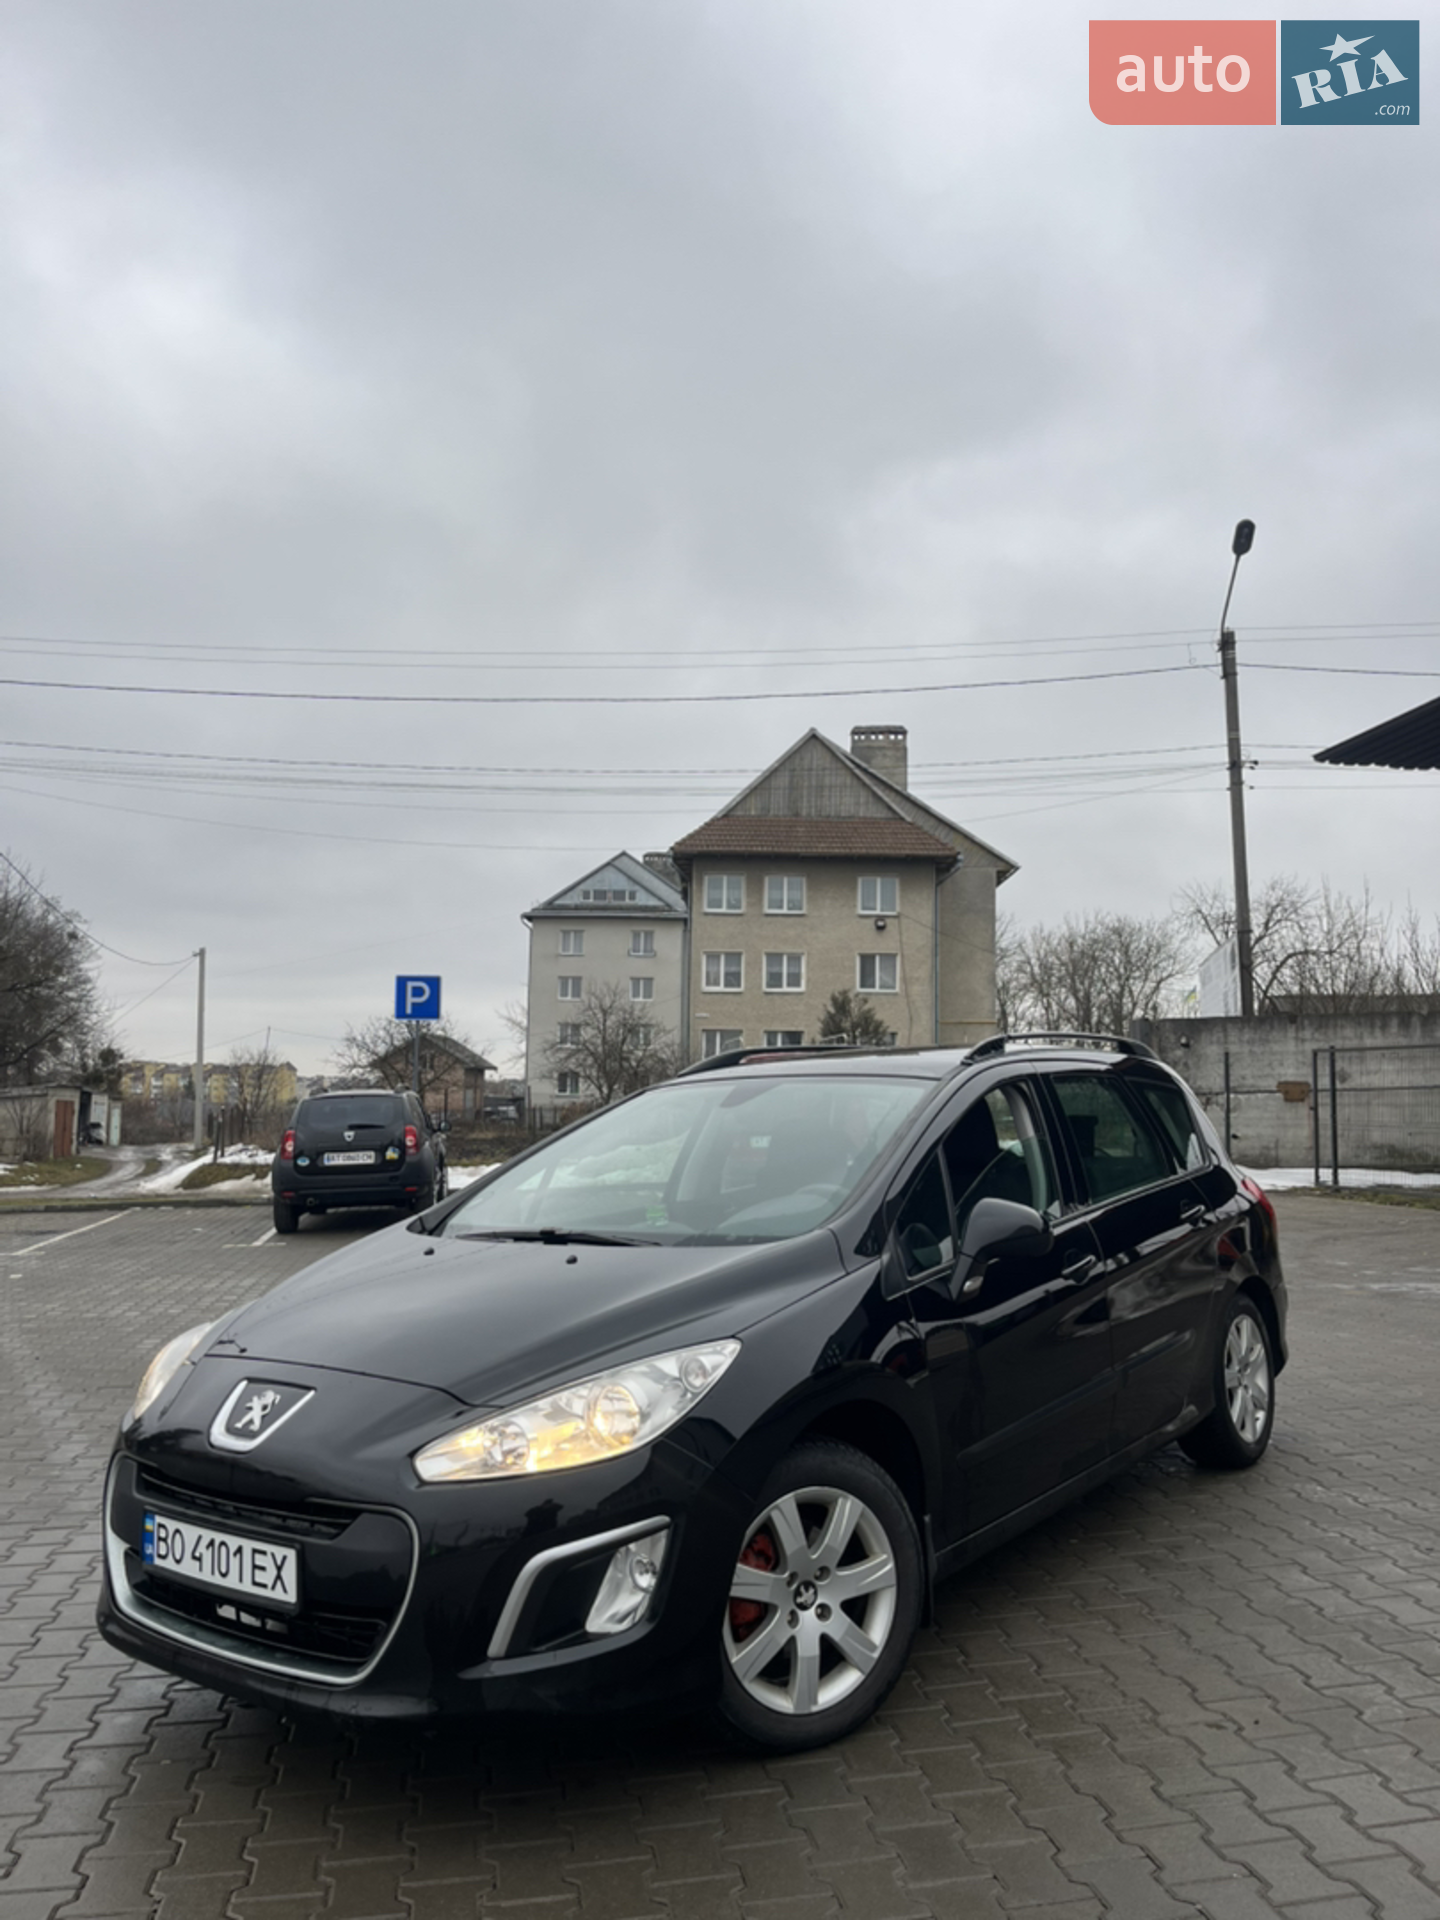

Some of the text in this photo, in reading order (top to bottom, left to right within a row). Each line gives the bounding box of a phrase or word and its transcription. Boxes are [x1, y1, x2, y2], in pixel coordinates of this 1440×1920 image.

[405, 981, 431, 1014] P
[156, 1523, 288, 1594] BO 4101 EX
